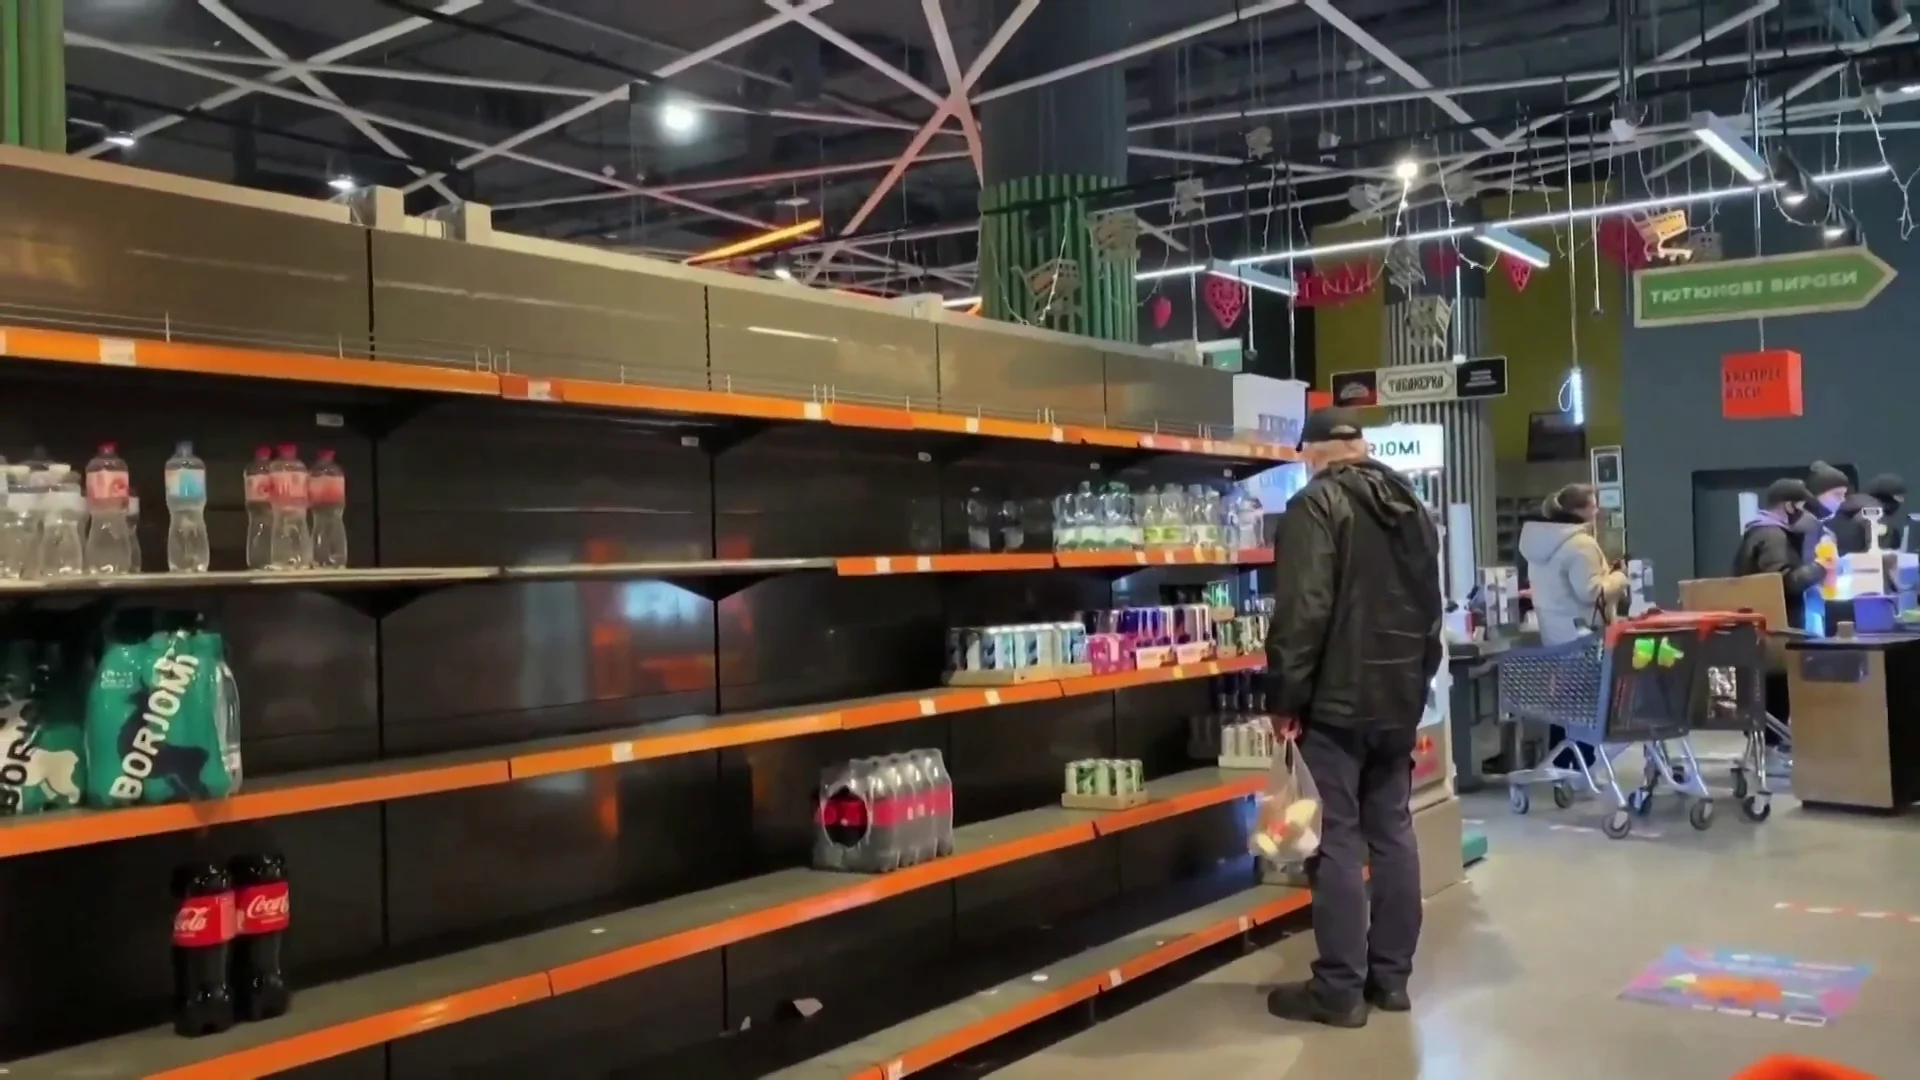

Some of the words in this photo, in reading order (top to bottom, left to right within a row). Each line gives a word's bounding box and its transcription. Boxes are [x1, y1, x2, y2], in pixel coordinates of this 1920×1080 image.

[1650, 282, 1763, 304] ТЮТЮНОВІ
[1771, 271, 1857, 293] ВИРОБИ
[1368, 440, 1421, 456] RJOMI
[109, 654, 199, 799] BORJOMI
